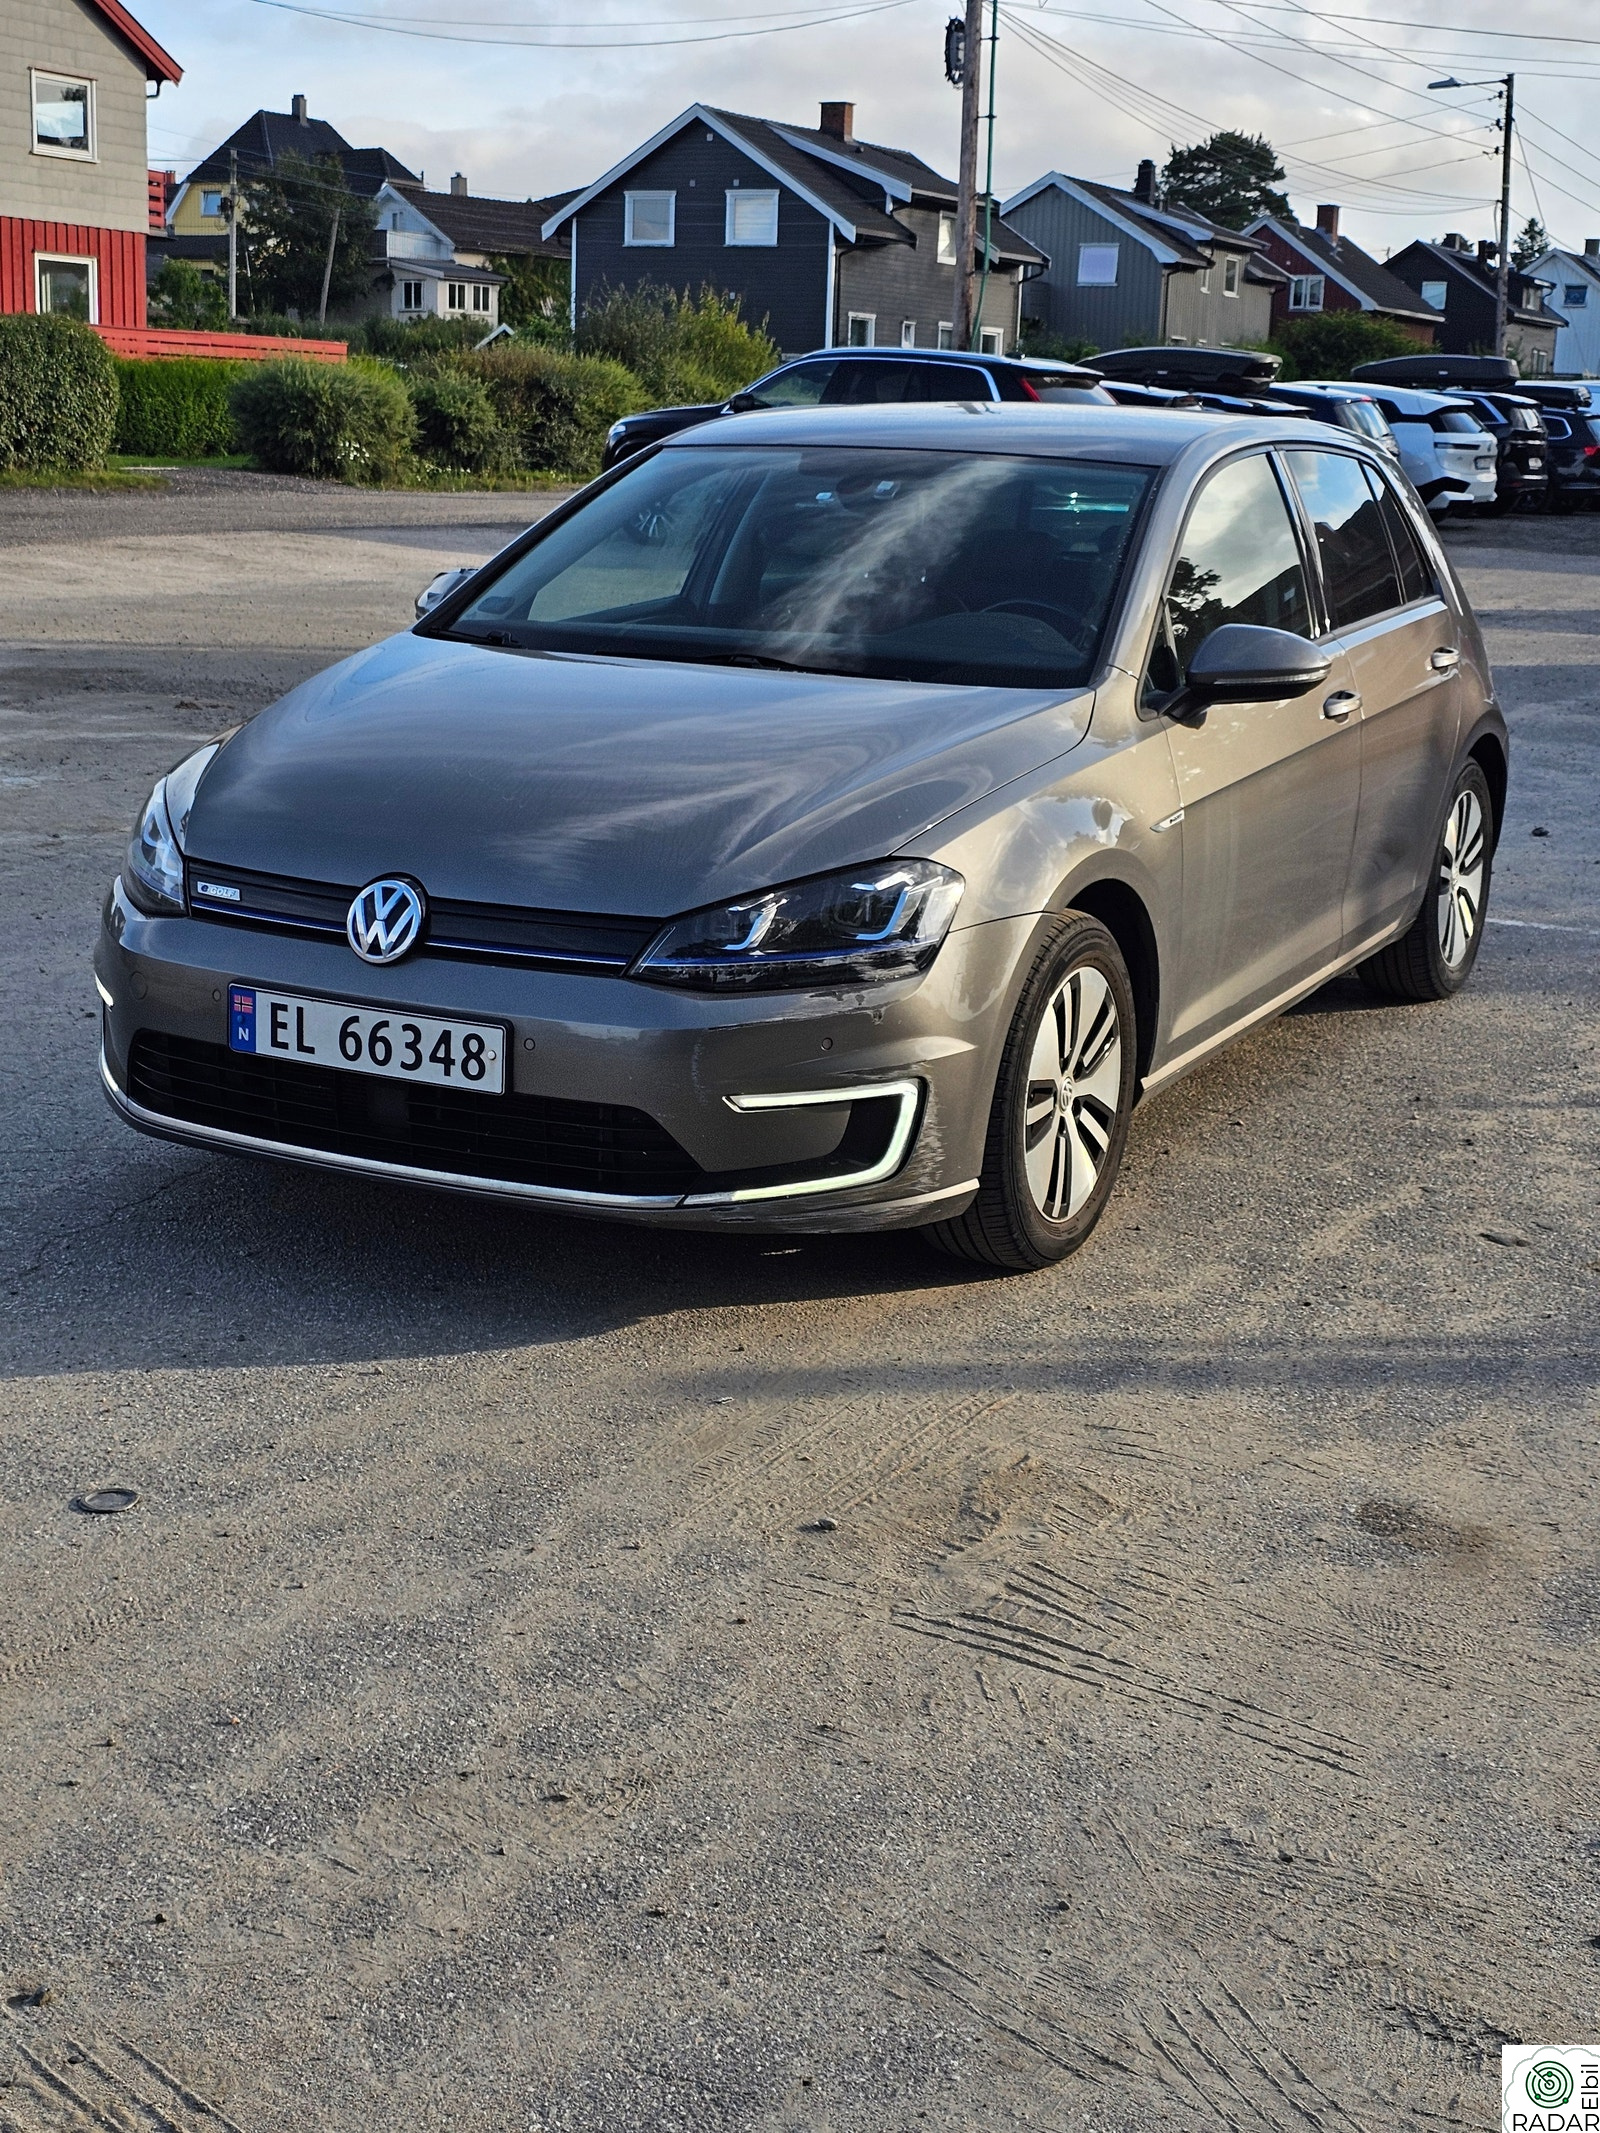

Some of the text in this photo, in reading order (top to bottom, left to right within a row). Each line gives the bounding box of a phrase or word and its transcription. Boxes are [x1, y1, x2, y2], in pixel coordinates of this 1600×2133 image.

[351, 884, 418, 960] VW
[238, 1026, 249, 1041] N
[270, 1002, 486, 1081] EL 66348
